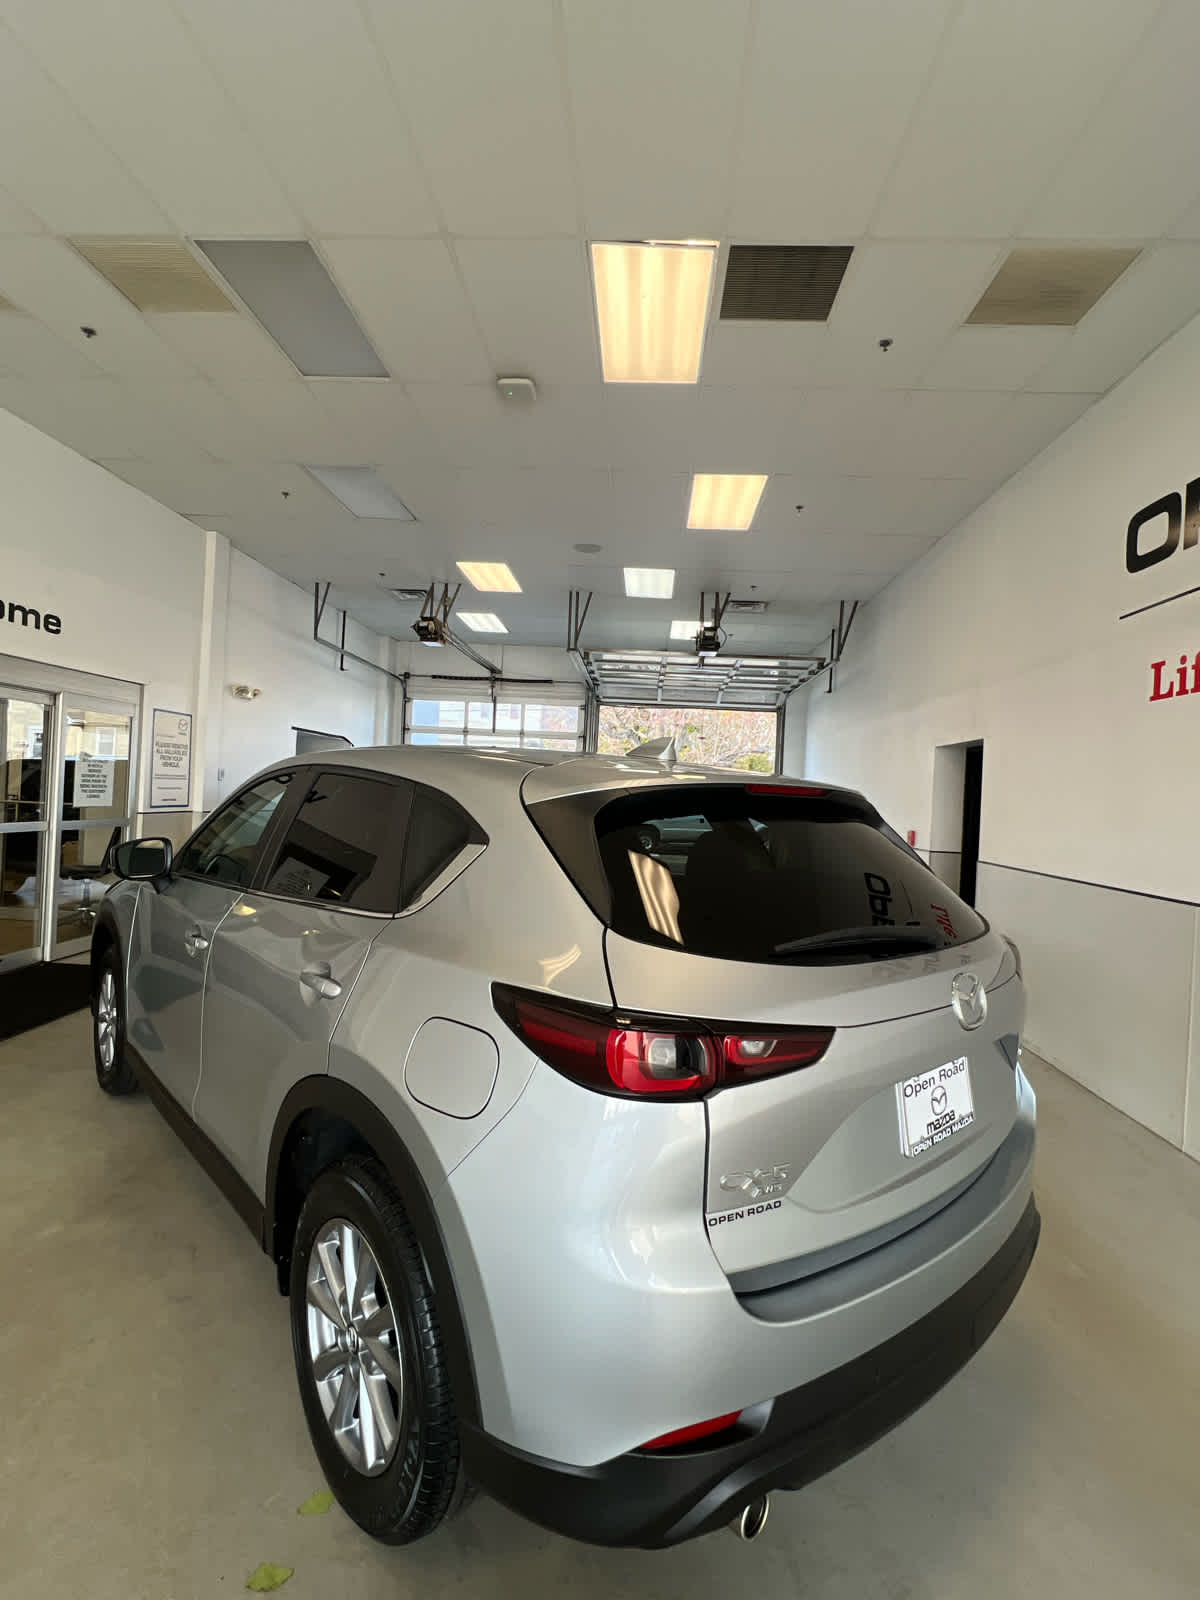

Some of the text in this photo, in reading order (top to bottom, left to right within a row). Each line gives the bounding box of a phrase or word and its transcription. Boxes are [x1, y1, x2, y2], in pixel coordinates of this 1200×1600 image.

[1126, 477, 1200, 573] O
[0, 599, 61, 635] me
[904, 1060, 965, 1097] Open Road
[927, 1110, 956, 1134] mazda
[912, 1138, 933, 1156] OPEN
[933, 1127, 951, 1144] ROAD
[720, 1162, 791, 1191] CX-5
[708, 1200, 782, 1227] OPEN ROAD
